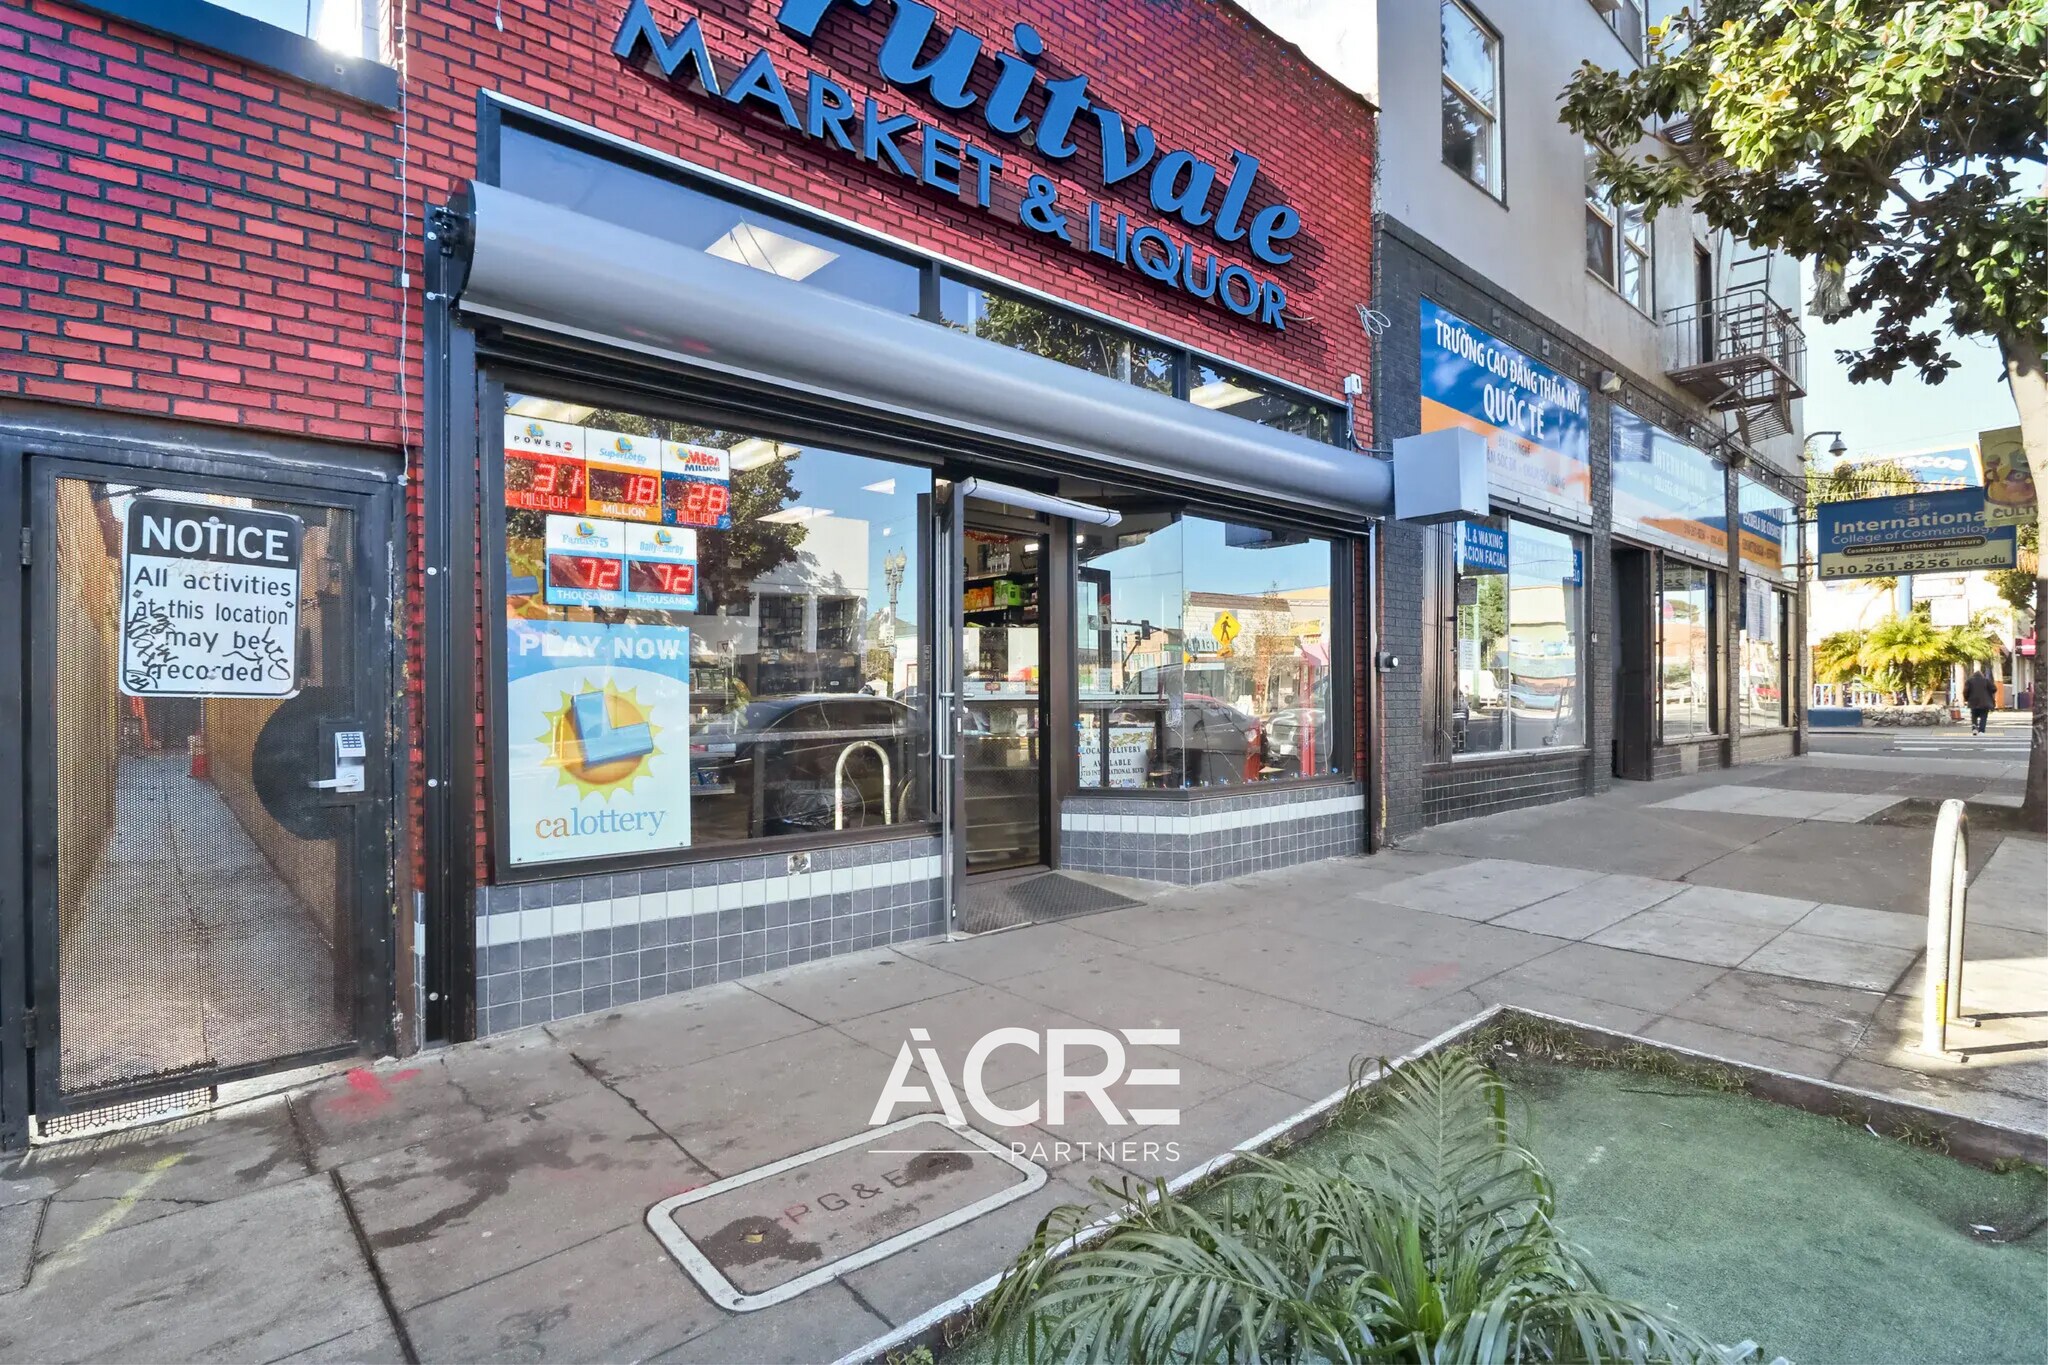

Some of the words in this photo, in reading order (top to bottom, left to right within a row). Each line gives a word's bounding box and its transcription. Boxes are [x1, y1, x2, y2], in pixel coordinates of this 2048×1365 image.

[611, 0, 1003, 208] MARKET
[1019, 173, 1072, 245] &
[1088, 201, 1287, 331] LIQUOR
[1487, 348, 1508, 378] CAO
[1483, 383, 1526, 432] QUỐC
[1528, 401, 1545, 440] TẾ
[514, 435, 561, 449] POWER
[684, 463, 721, 473] MILLIONS
[685, 450, 720, 467] MEGA
[520, 491, 569, 510] MILLION
[626, 477, 657, 504] 18
[602, 503, 646, 518] MILLION
[1834, 512, 1985, 534] Internationa
[142, 515, 289, 562] NOTICE
[562, 534, 599, 547] Fantasy
[599, 537, 609, 548] 5
[1473, 532, 1478, 543] &
[1479, 533, 1503, 549] WAXING
[1832, 533, 1881, 544] College
[1885, 530, 1900, 540] of
[1902, 524, 1998, 538] Cosmetology
[1847, 545, 1895, 554] Cosmetology
[1901, 542, 1937, 551] Esthetics
[1943, 539, 1982, 547] Manicure
[1485, 551, 1507, 568] FACIAL
[1826, 558, 1950, 575] 510.261.8256
[1956, 555, 2006, 566] icoc.edu
[134, 566, 167, 587] All
[183, 573, 291, 597] activities
[581, 558, 620, 588] 72
[658, 564, 693, 592] 72
[556, 590, 615, 602] THOUSAND
[636, 594, 691, 605] THOUSAND
[136, 599, 156, 617] at
[168, 600, 204, 620] this
[215, 603, 288, 625] location
[165, 631, 218, 653] may
[233, 631, 260, 650] be
[519, 633, 602, 657] PLAY
[613, 637, 682, 660] NOW
[155, 664, 263, 682] recorded
[1109, 746, 1141, 754] DELIVERY
[1093, 759, 1131, 767] AVLABLE
[535, 807, 666, 839] calottery
